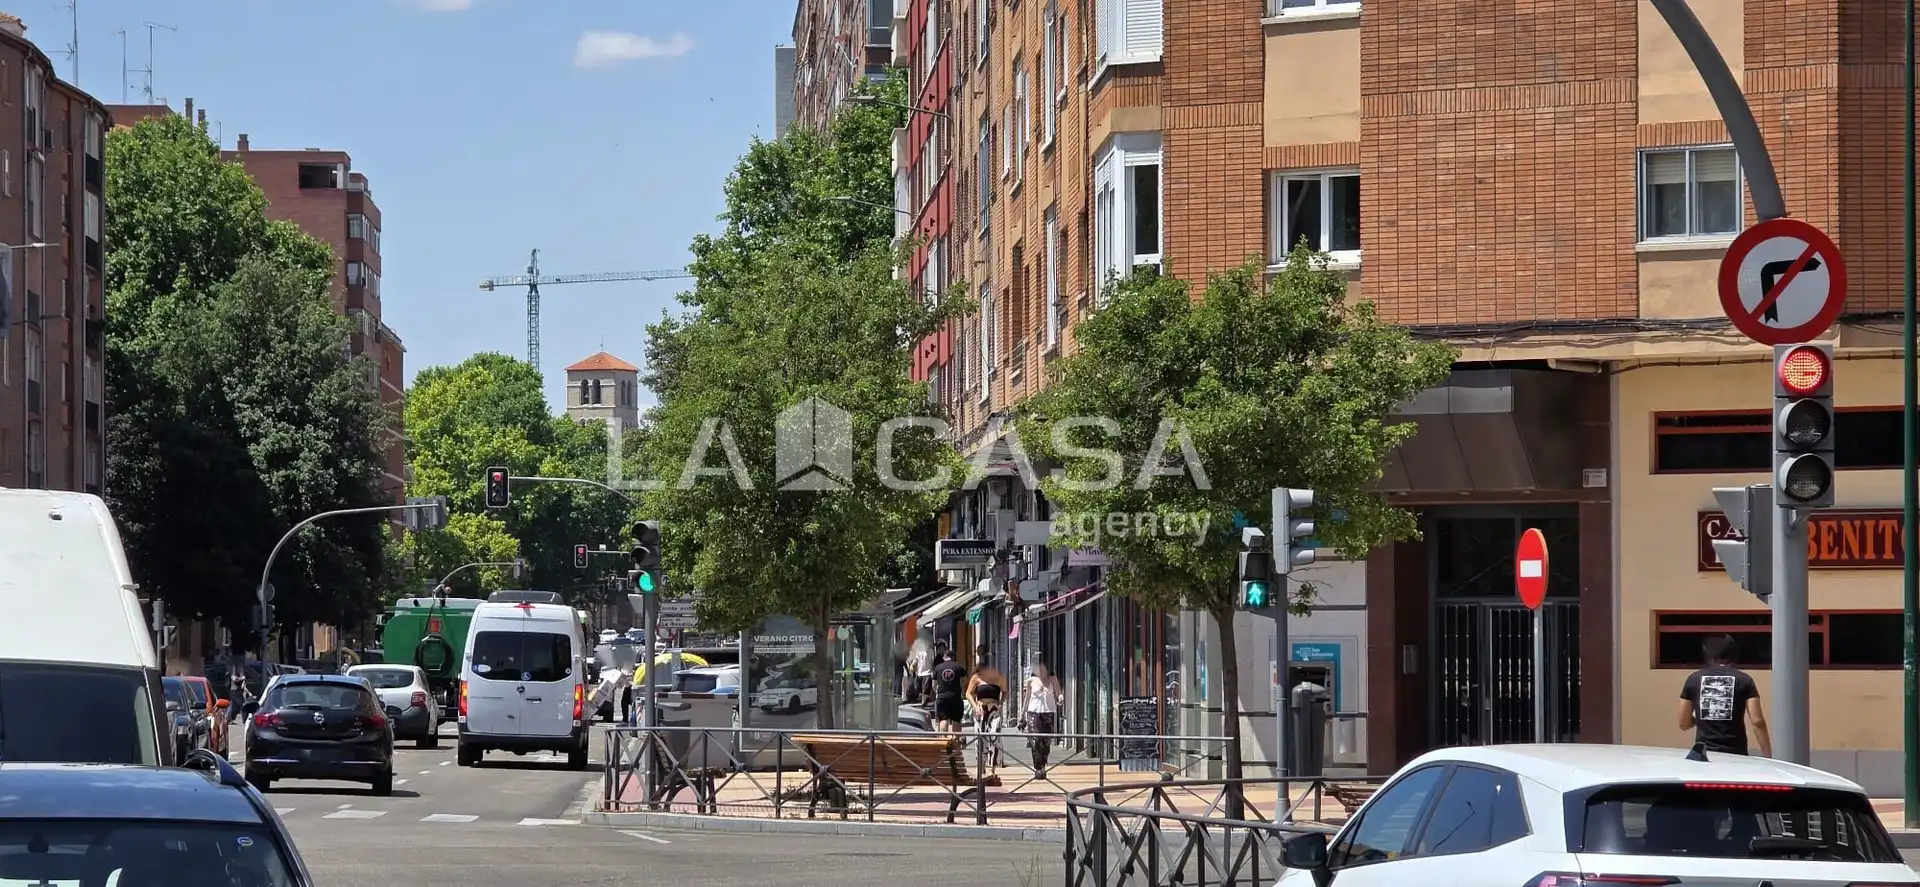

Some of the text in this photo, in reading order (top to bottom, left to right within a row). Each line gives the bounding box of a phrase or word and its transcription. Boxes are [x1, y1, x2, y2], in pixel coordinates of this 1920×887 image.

[1706, 519, 1747, 538] CA
[1807, 519, 1906, 560] BENIT
[942, 547, 960, 555] PURA
